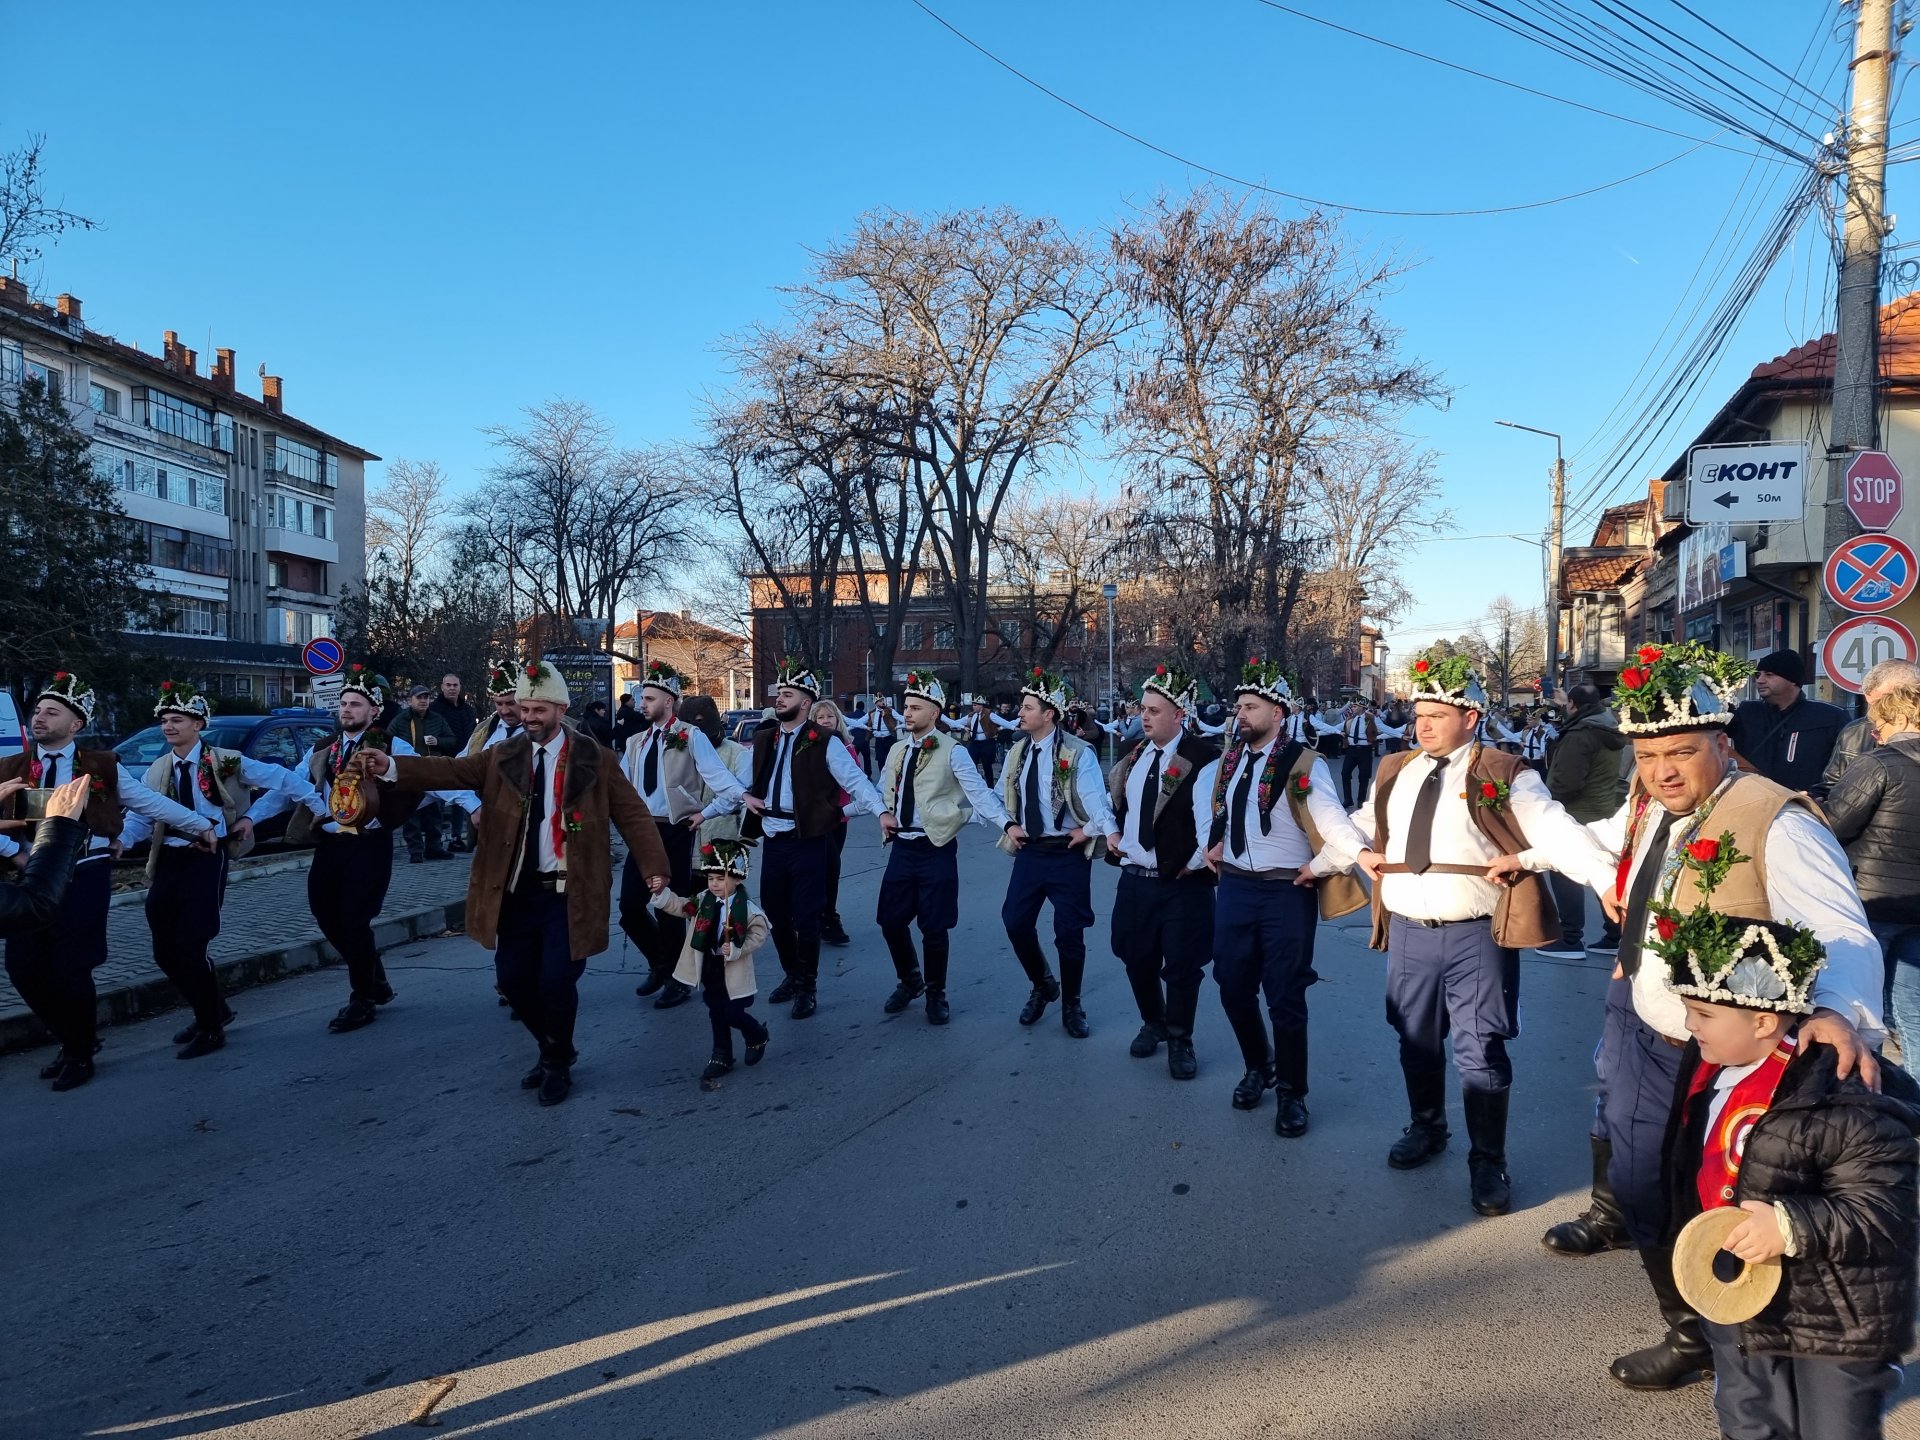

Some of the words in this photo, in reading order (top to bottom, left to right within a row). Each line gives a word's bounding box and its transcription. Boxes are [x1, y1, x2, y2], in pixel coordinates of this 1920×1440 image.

[1700, 462, 1798, 484] ЕКОНТ
[1757, 493, 1782, 503] 50м
[1853, 476, 1896, 504] STOP
[1841, 636, 1895, 673] 40
